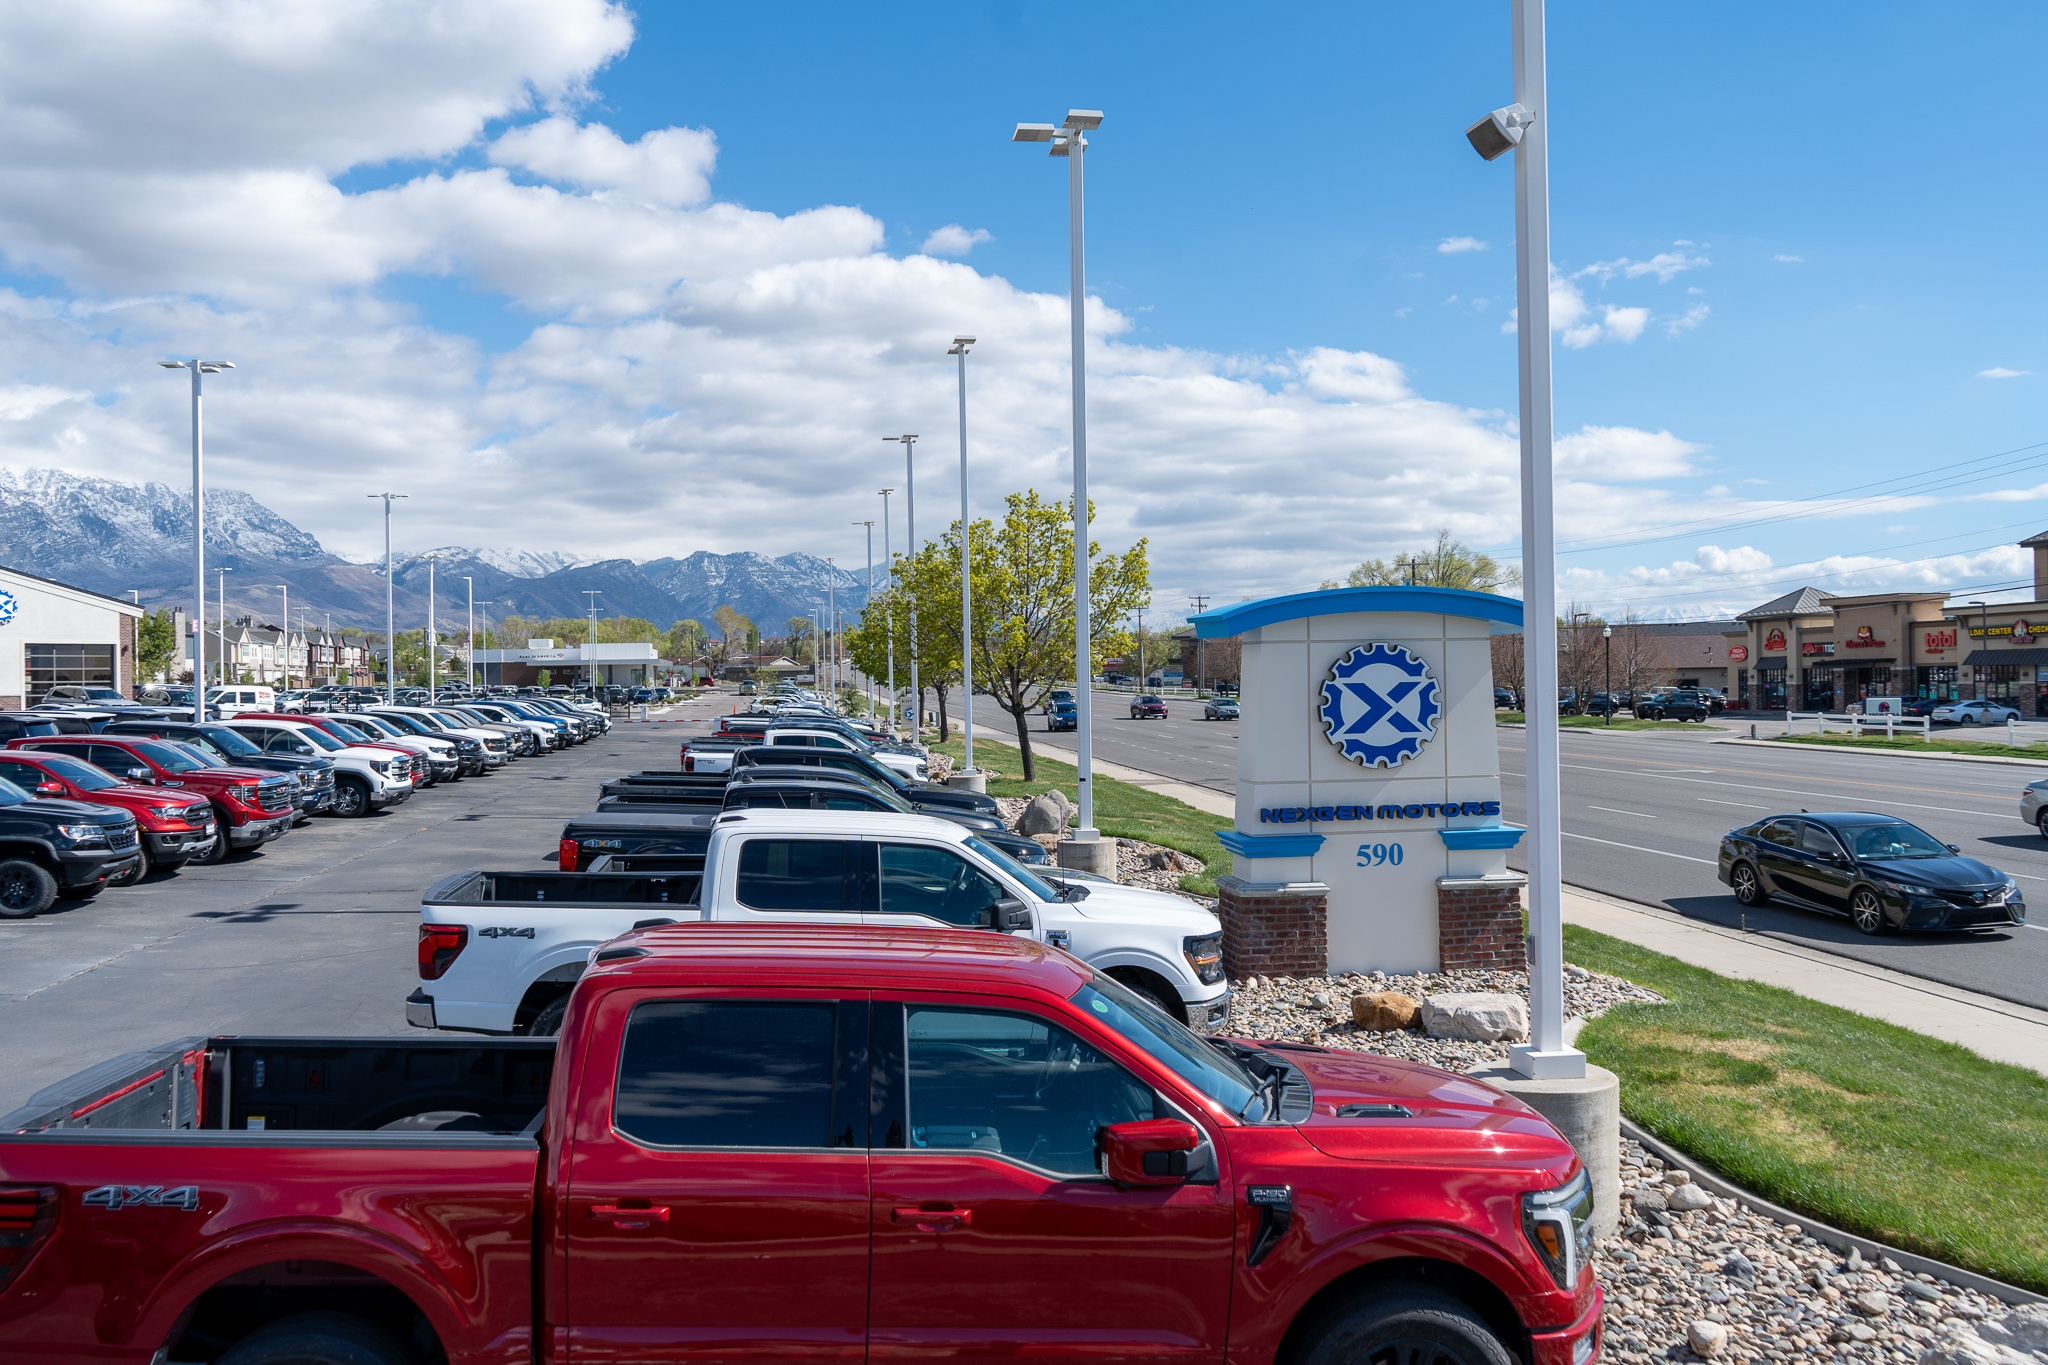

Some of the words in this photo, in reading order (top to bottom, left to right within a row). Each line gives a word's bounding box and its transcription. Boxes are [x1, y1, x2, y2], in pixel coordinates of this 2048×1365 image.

[1925, 629, 1957, 647] total
[1987, 627, 2012, 635] CENTER
[1260, 805, 1374, 823] NEXGEN
[1377, 801, 1500, 820] MOTORS
[1356, 843, 1404, 867] 590
